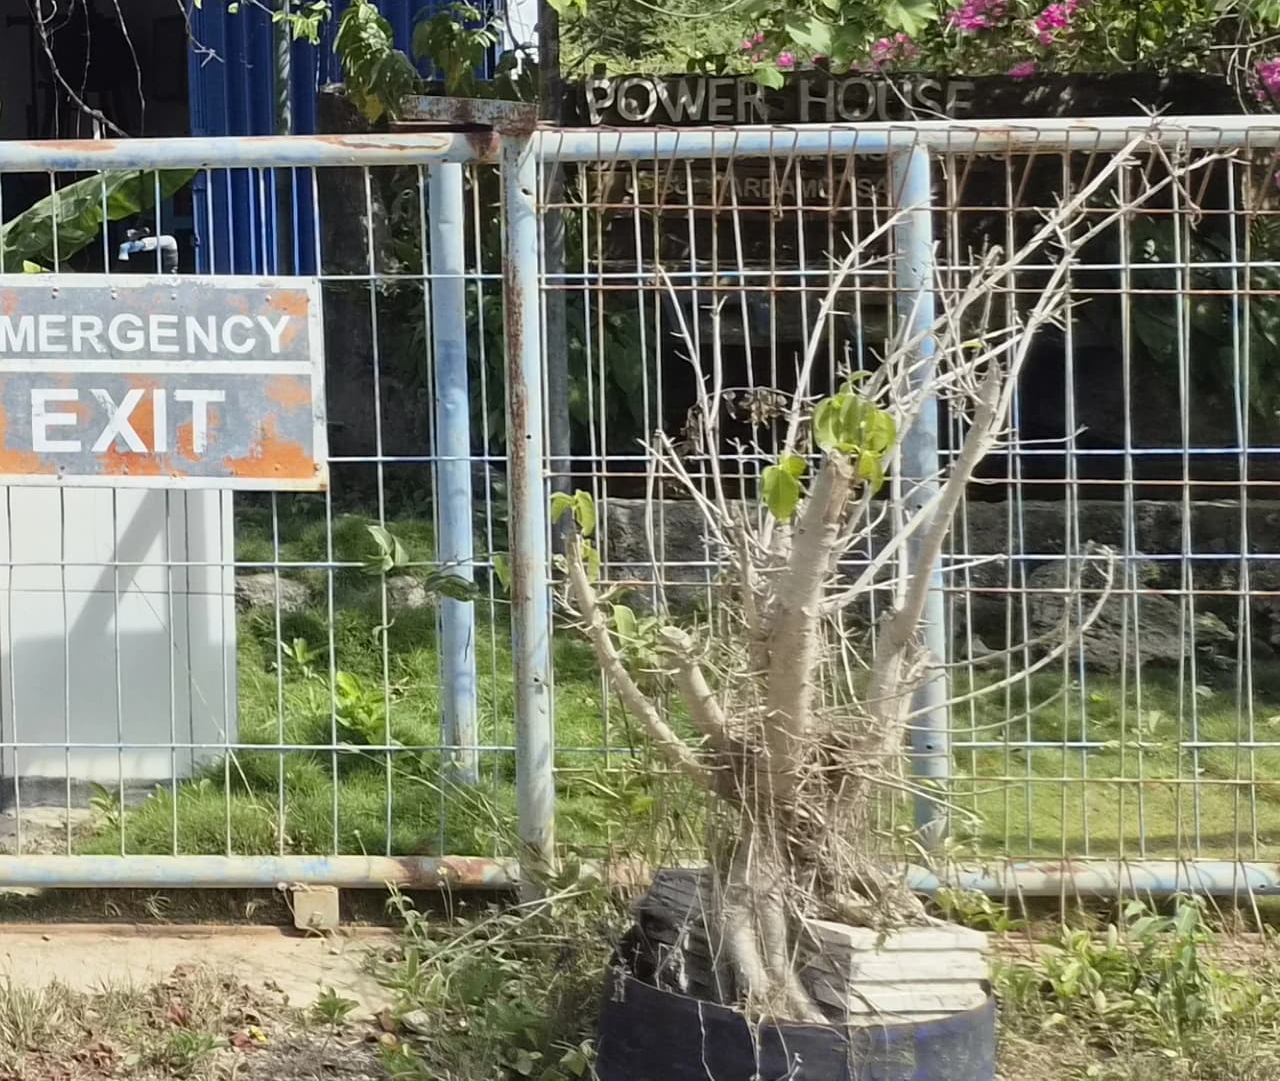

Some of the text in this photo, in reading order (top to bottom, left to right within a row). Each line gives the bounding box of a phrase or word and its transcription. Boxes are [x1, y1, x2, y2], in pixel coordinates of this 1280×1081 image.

[585, 76, 976, 125] POWER HOUSE
[30, 387, 226, 453] EXIT
